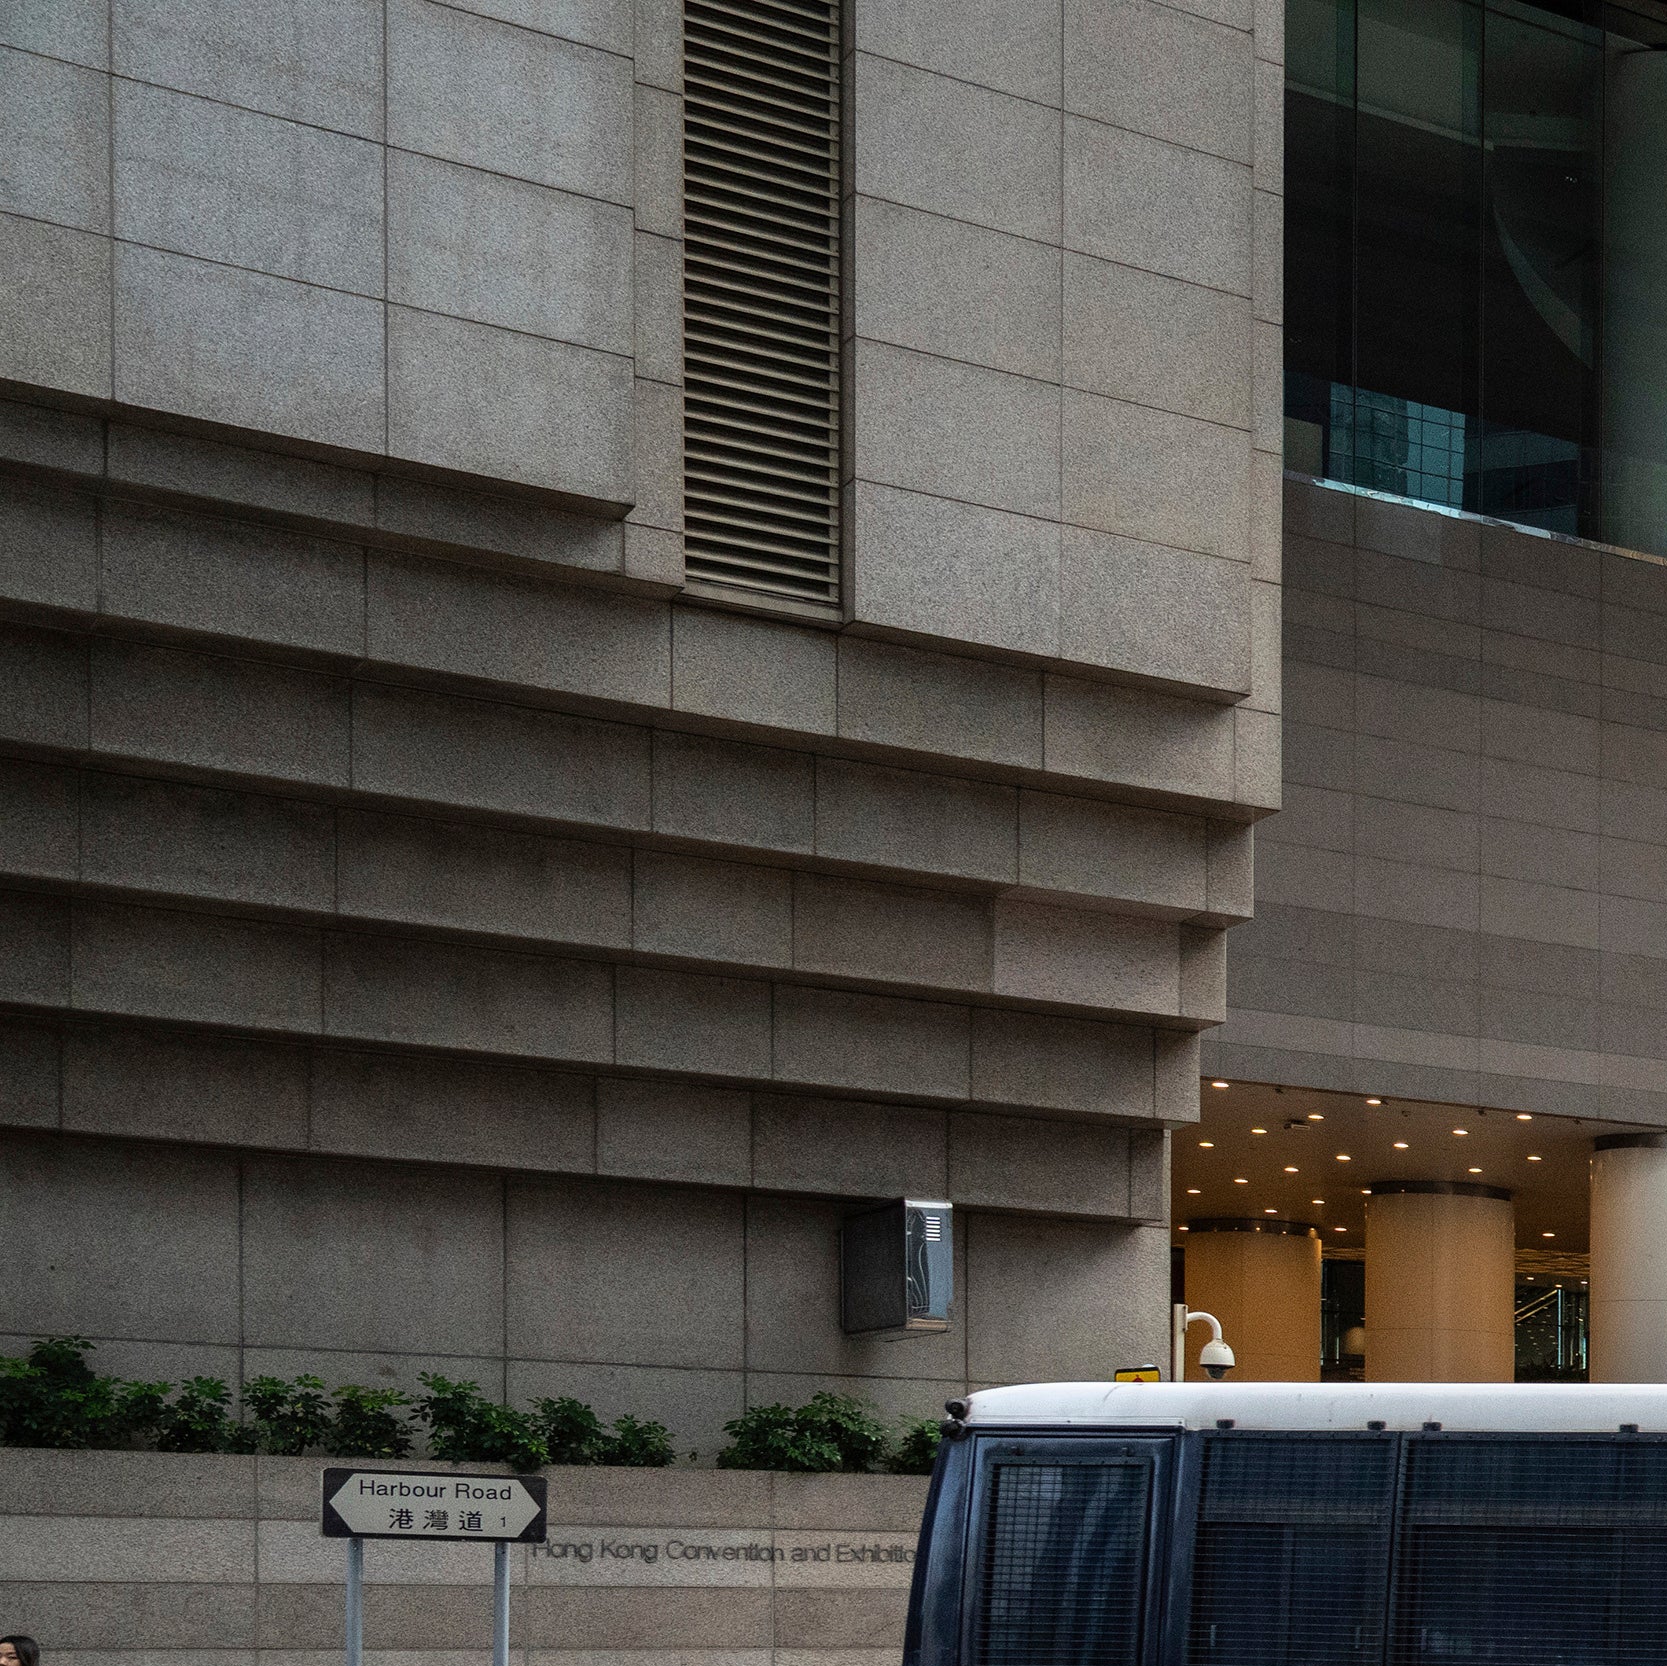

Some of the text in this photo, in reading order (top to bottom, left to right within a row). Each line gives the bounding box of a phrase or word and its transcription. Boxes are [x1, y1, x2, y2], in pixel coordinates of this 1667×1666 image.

[359, 1479, 512, 1501] Harbour Road
[388, 1507, 484, 1532] 港灣道
[532, 1538, 594, 1563] Hong
[601, 1540, 659, 1564] Kong
[666, 1540, 786, 1563] Convention
[790, 1543, 832, 1563] and
